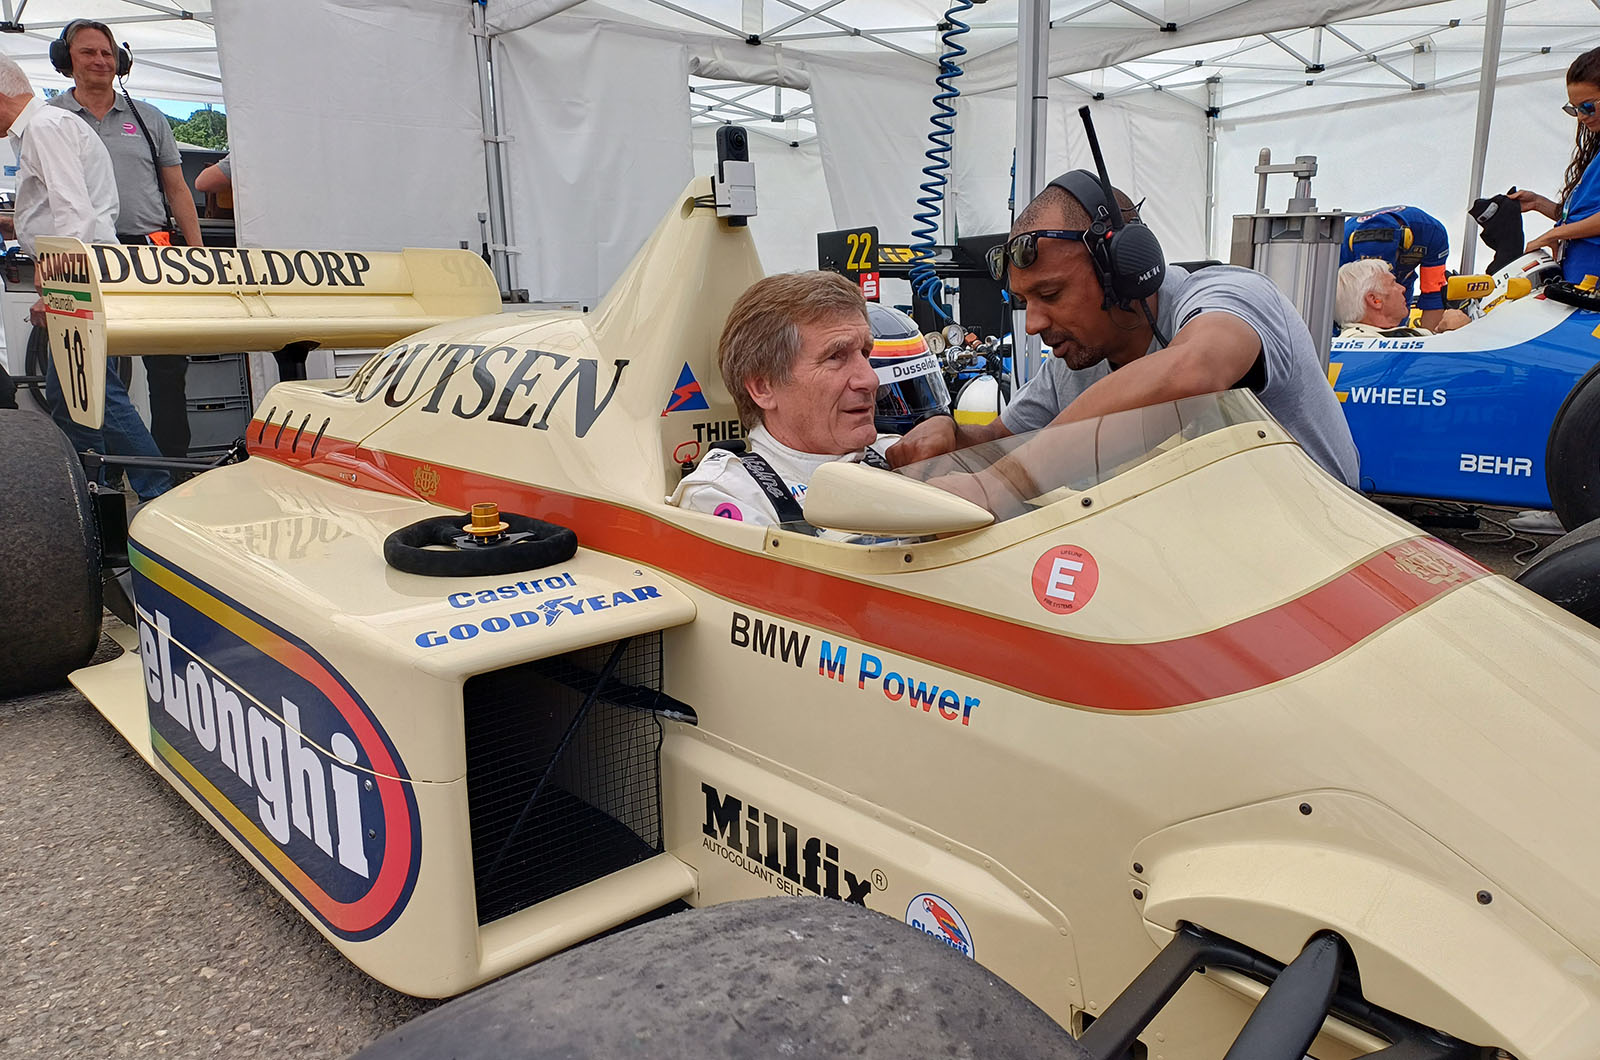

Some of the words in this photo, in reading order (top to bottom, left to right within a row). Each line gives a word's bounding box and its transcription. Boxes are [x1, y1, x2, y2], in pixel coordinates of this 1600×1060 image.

[39, 252, 90, 284] CAMOZZI
[847, 233, 872, 270] 22
[48, 292, 75, 312] Pneumatic
[1330, 340, 1364, 349] aris
[63, 329, 88, 412] 18
[1351, 387, 1447, 406] WHEELS
[1460, 453, 1533, 476] BEHR
[1060, 550, 1083, 558] LIFELINE
[447, 572, 577, 609] Castrol
[1045, 557, 1084, 602] E
[730, 611, 811, 668] BMW
[818, 640, 848, 683] M
[858, 653, 980, 727] Power
[702, 837, 774, 884] AUTOCOLLANT
